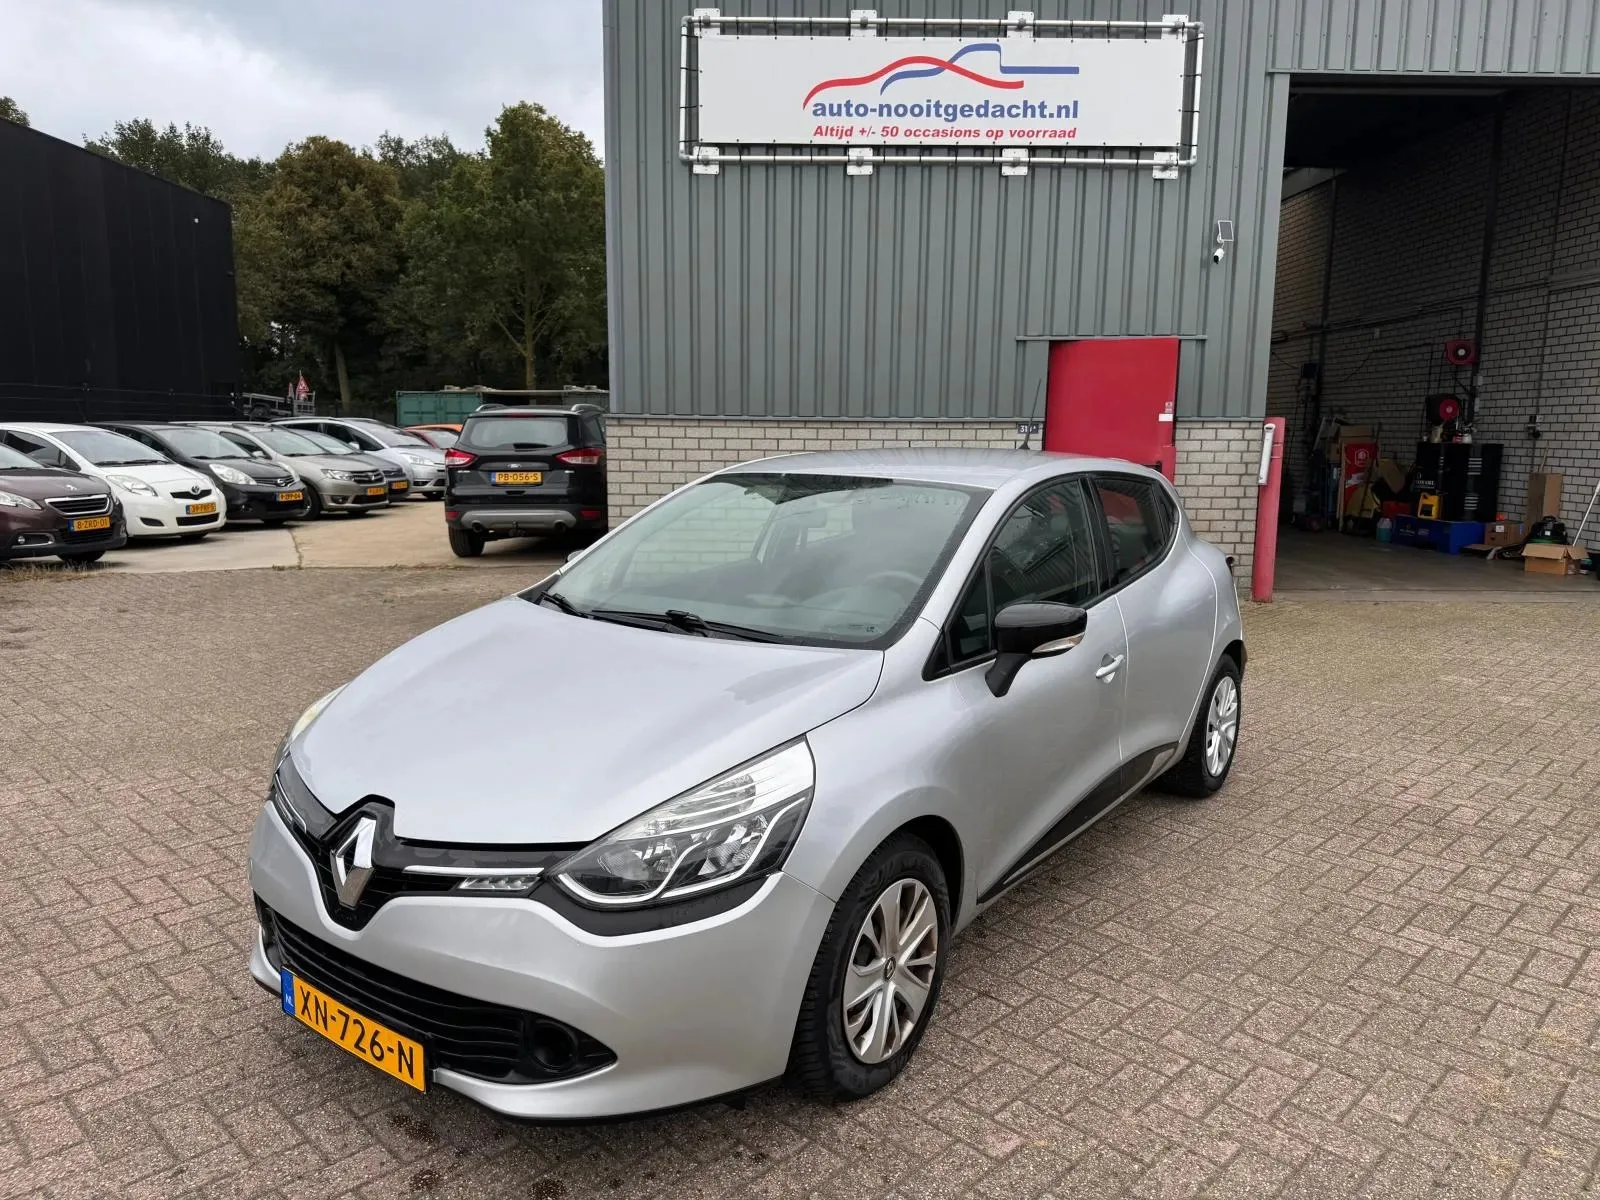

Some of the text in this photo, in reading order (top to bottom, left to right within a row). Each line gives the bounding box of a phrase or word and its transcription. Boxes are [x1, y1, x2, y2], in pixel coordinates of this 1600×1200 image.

[812, 99, 1079, 122] auto-nooitgedacht.nl
[813, 125, 1077, 140] Altijd +/- 50 occasions op voorraad
[498, 473, 539, 481] PB-056-S
[77, 518, 108, 529] 8-ZRD-01
[300, 985, 414, 1080] XN-726-N
